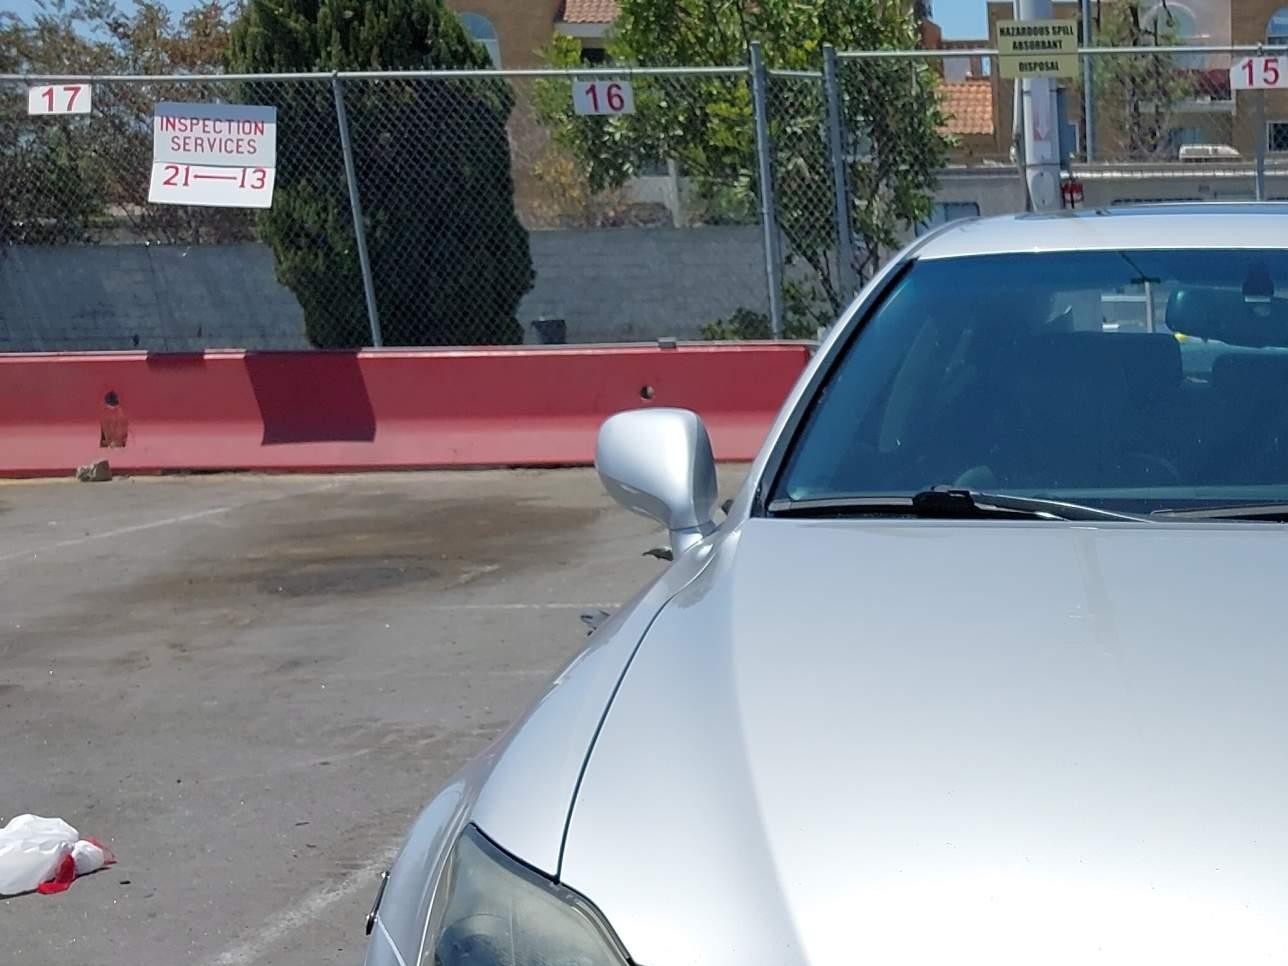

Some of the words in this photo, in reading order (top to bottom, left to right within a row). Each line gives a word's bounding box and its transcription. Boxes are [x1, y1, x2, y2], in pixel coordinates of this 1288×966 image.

[999, 26, 1050, 36] HAZARDOUS
[1051, 25, 1073, 36] SPILL
[1018, 61, 1059, 73] DISPOSAL
[1241, 58, 1279, 87] 15
[41, 86, 82, 112] 17
[585, 83, 625, 113] 16
[159, 114, 265, 136] INSPECTION
[171, 135, 257, 154] SERVICES
